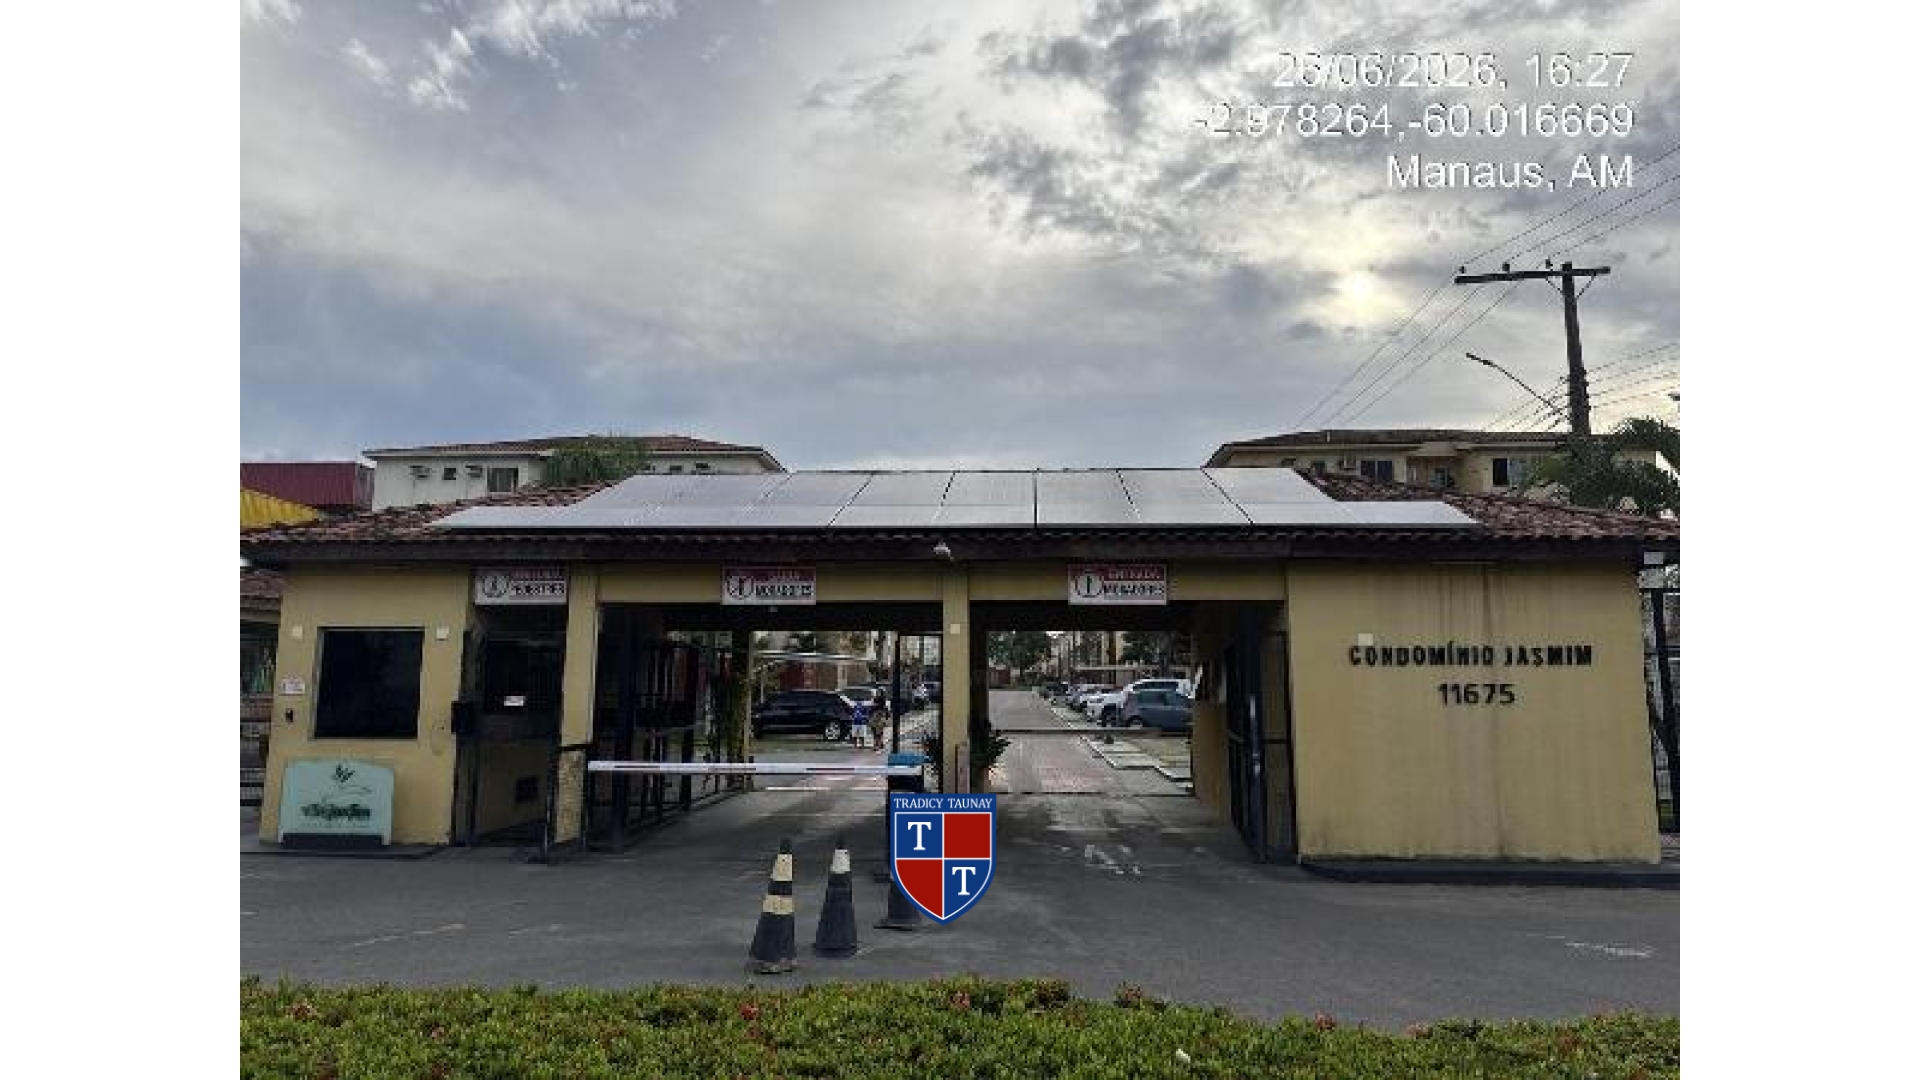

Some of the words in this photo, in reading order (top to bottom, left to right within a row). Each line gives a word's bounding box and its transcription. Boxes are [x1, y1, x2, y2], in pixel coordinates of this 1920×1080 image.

[1349, 640, 1495, 667] CONDOMÍNIO
[1503, 644, 1593, 667] JASMIM
[1437, 682, 1516, 706] 11675
